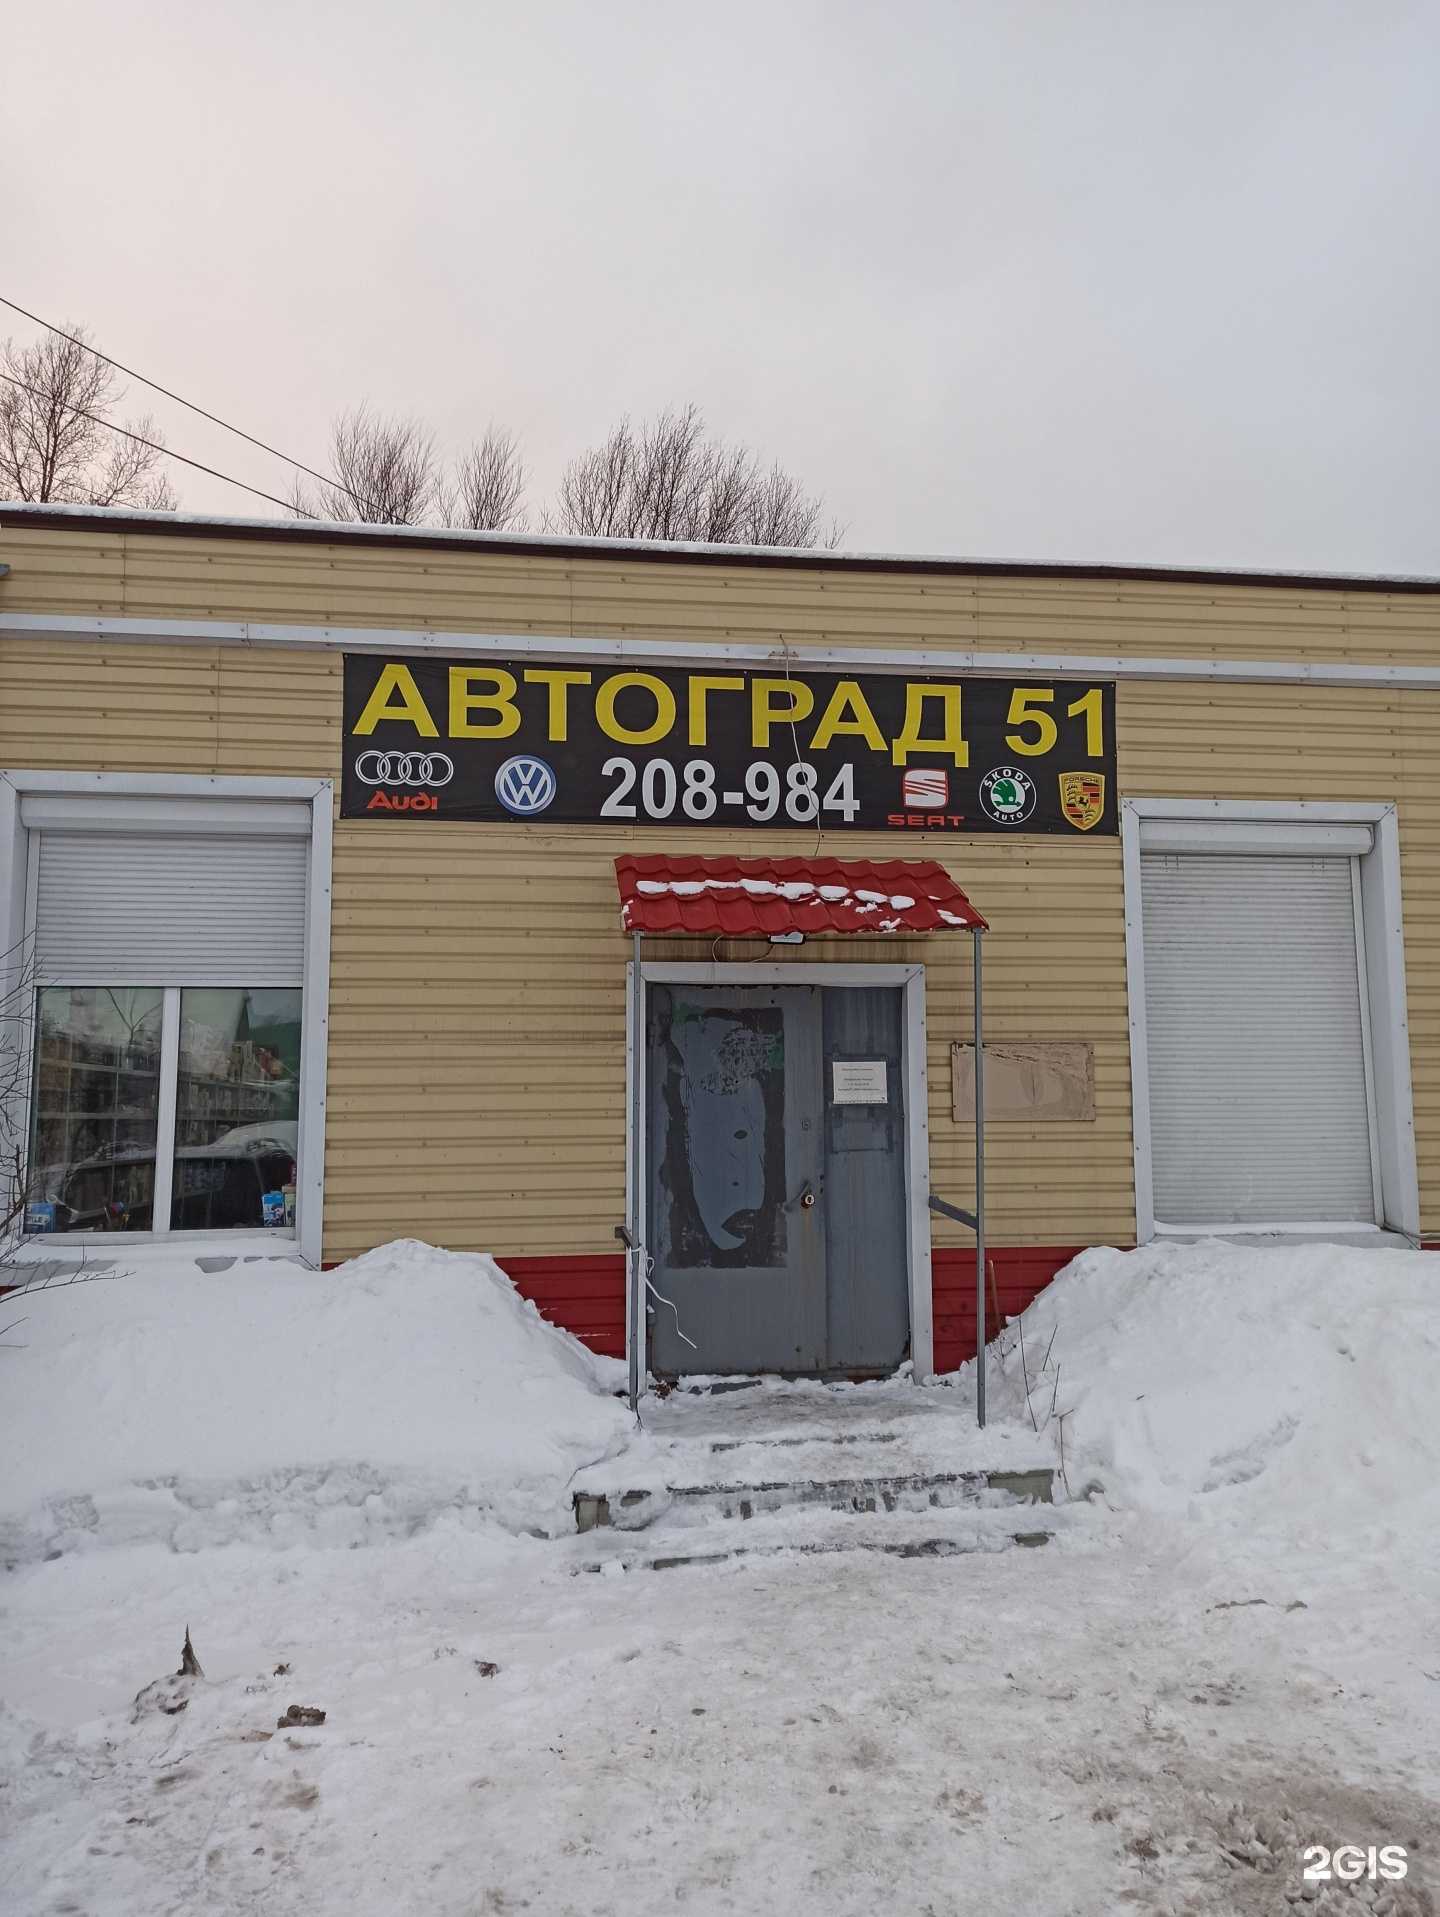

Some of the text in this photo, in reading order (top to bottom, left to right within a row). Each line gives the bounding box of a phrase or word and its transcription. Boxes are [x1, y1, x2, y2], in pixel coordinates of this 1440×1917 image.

[352, 664, 1104, 767] АВТОГРАД 51
[600, 757, 860, 821] 208-984
[984, 769, 1031, 791] SKODA
[367, 791, 439, 810] Audi
[887, 814, 966, 826] SEAT
[993, 811, 1024, 821] AUTO
